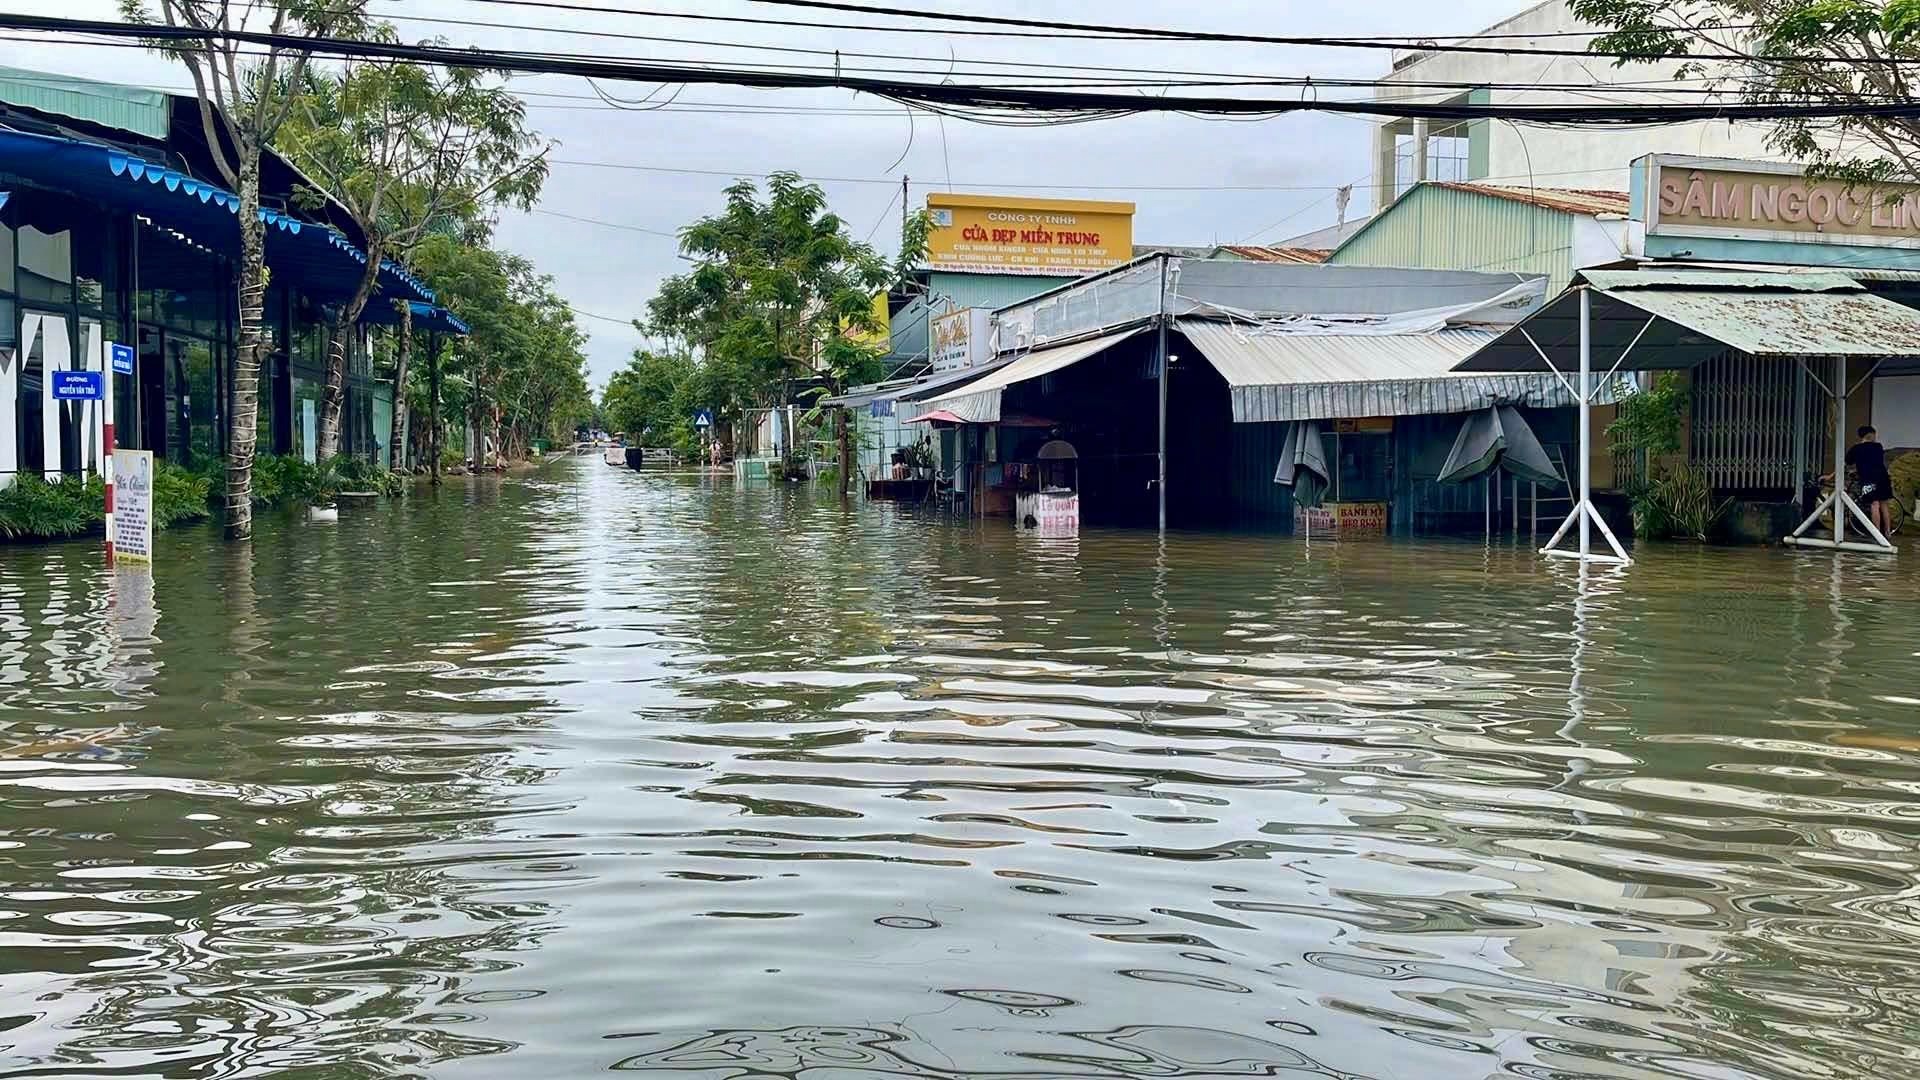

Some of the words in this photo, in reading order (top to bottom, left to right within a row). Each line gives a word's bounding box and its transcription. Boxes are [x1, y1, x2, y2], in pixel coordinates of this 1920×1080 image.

[1659, 171, 1746, 220] SÂM
[1751, 184, 1863, 232] NGỌC
[987, 210, 1025, 223] CÔNG
[1029, 214, 1042, 223] TY
[1045, 215, 1077, 225] TNHH
[962, 224, 988, 241] CỬA
[992, 229, 1017, 245] ĐẸP
[1056, 231, 1100, 246] TRUNG
